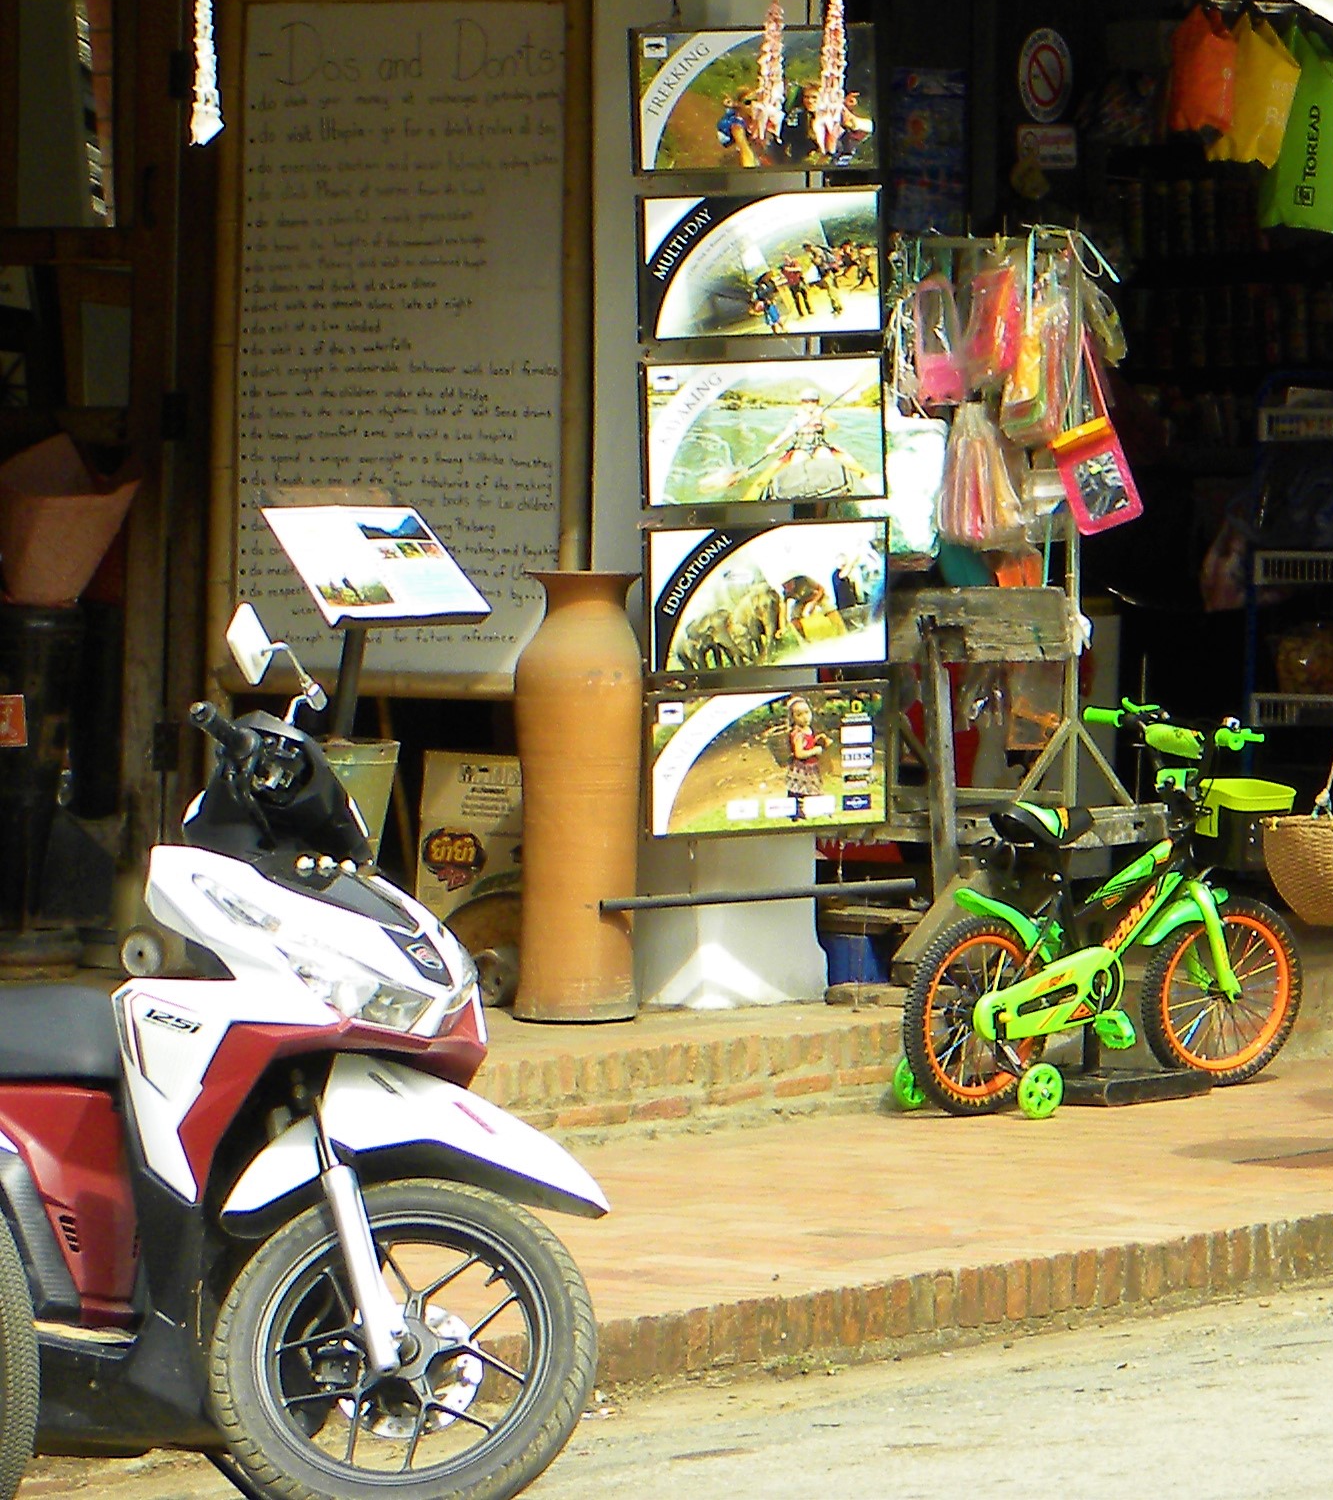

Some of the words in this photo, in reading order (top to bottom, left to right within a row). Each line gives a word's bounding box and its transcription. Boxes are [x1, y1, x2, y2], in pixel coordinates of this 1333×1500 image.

[378, 31, 423, 81] and
[645, 41, 712, 117] TREKKING
[1302, 104, 1320, 182] TOREAD
[652, 207, 713, 282] MULTI-DAY
[662, 533, 733, 617] EDUCATIONAL
[145, 1009, 203, 1034] 125i
